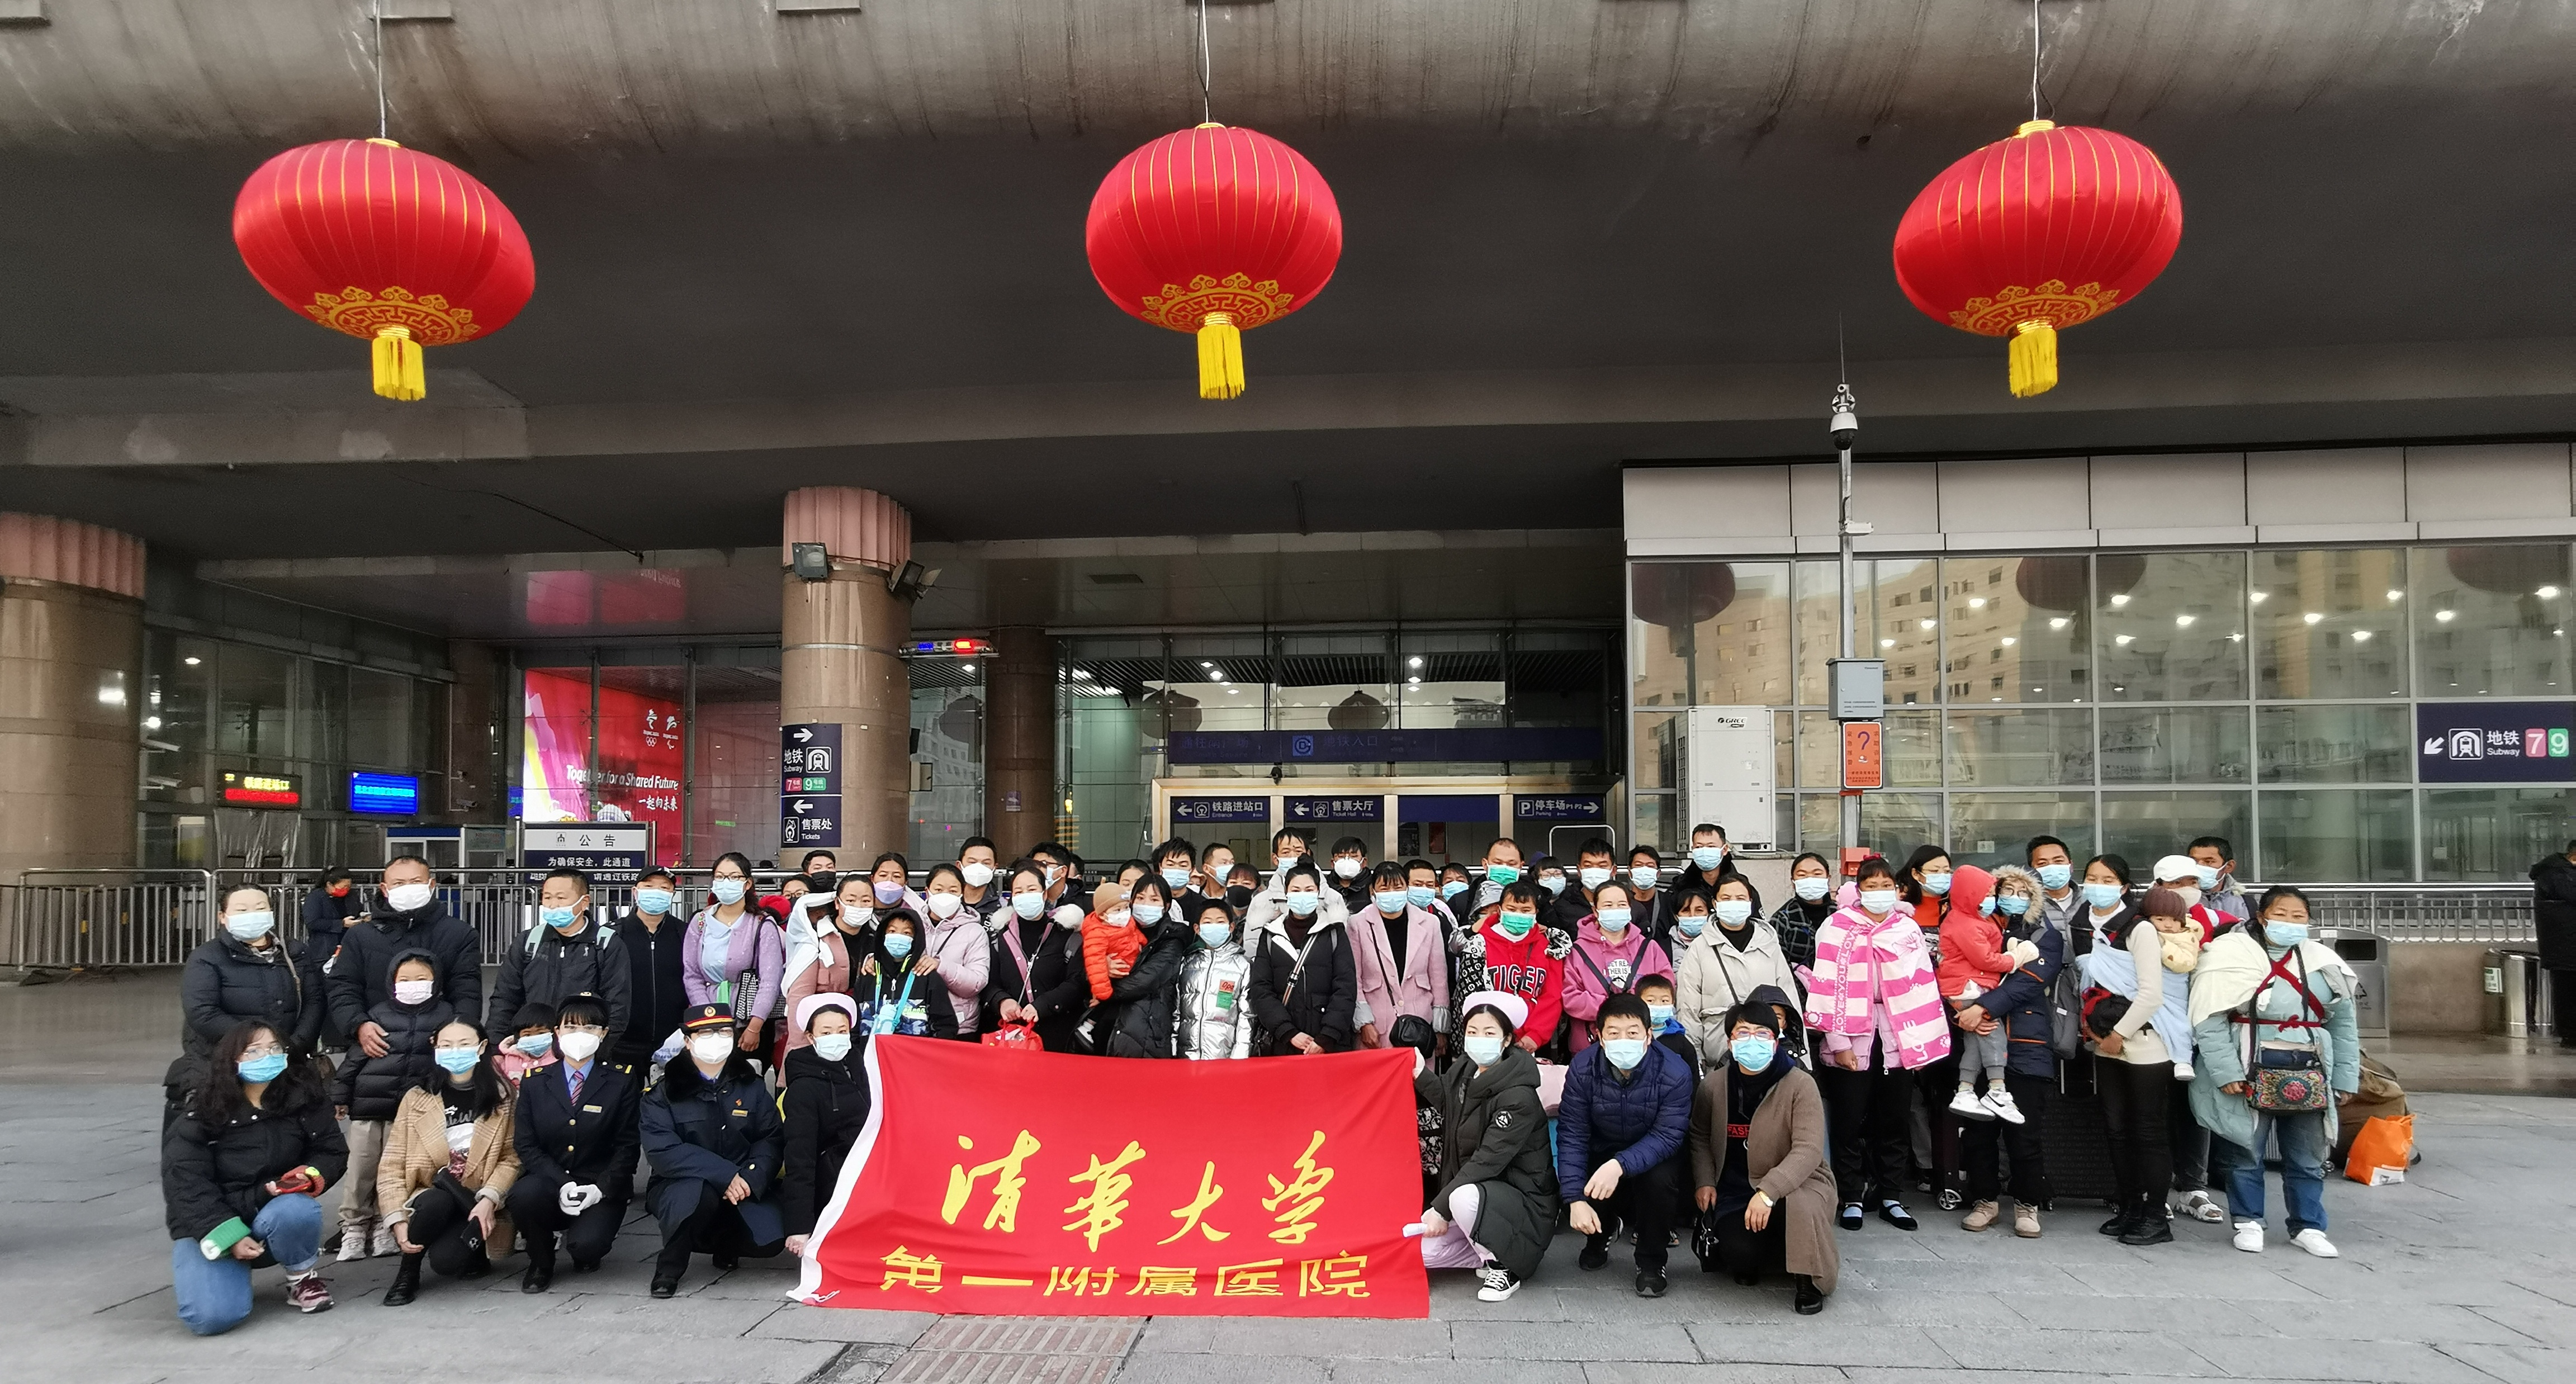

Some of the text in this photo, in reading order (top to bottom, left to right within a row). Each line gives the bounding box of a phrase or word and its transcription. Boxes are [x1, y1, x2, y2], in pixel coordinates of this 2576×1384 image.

[2487, 730, 2567, 755] 地铁 7 9
[784, 748, 803, 764] 地铁
[2487, 747, 2520, 757] Subway
[566, 764, 679, 790] Togeter for a Shared Future
[638, 794, 678, 811] 一起向未来
[1212, 801, 1263, 812] 铁路进站口
[1332, 800, 1374, 811] 售票大厅
[1535, 800, 1565, 811] 停车场
[801, 818, 832, 830] 售票处
[579, 834, 615, 847] 公告
[1487, 964, 1547, 998] TIGER
[1837, 965, 1846, 993] YOU
[1835, 1000, 1846, 1034] LOVE
[1902, 1020, 1929, 1061] LOE
[879, 1245, 1371, 1298] 第一附属医院
